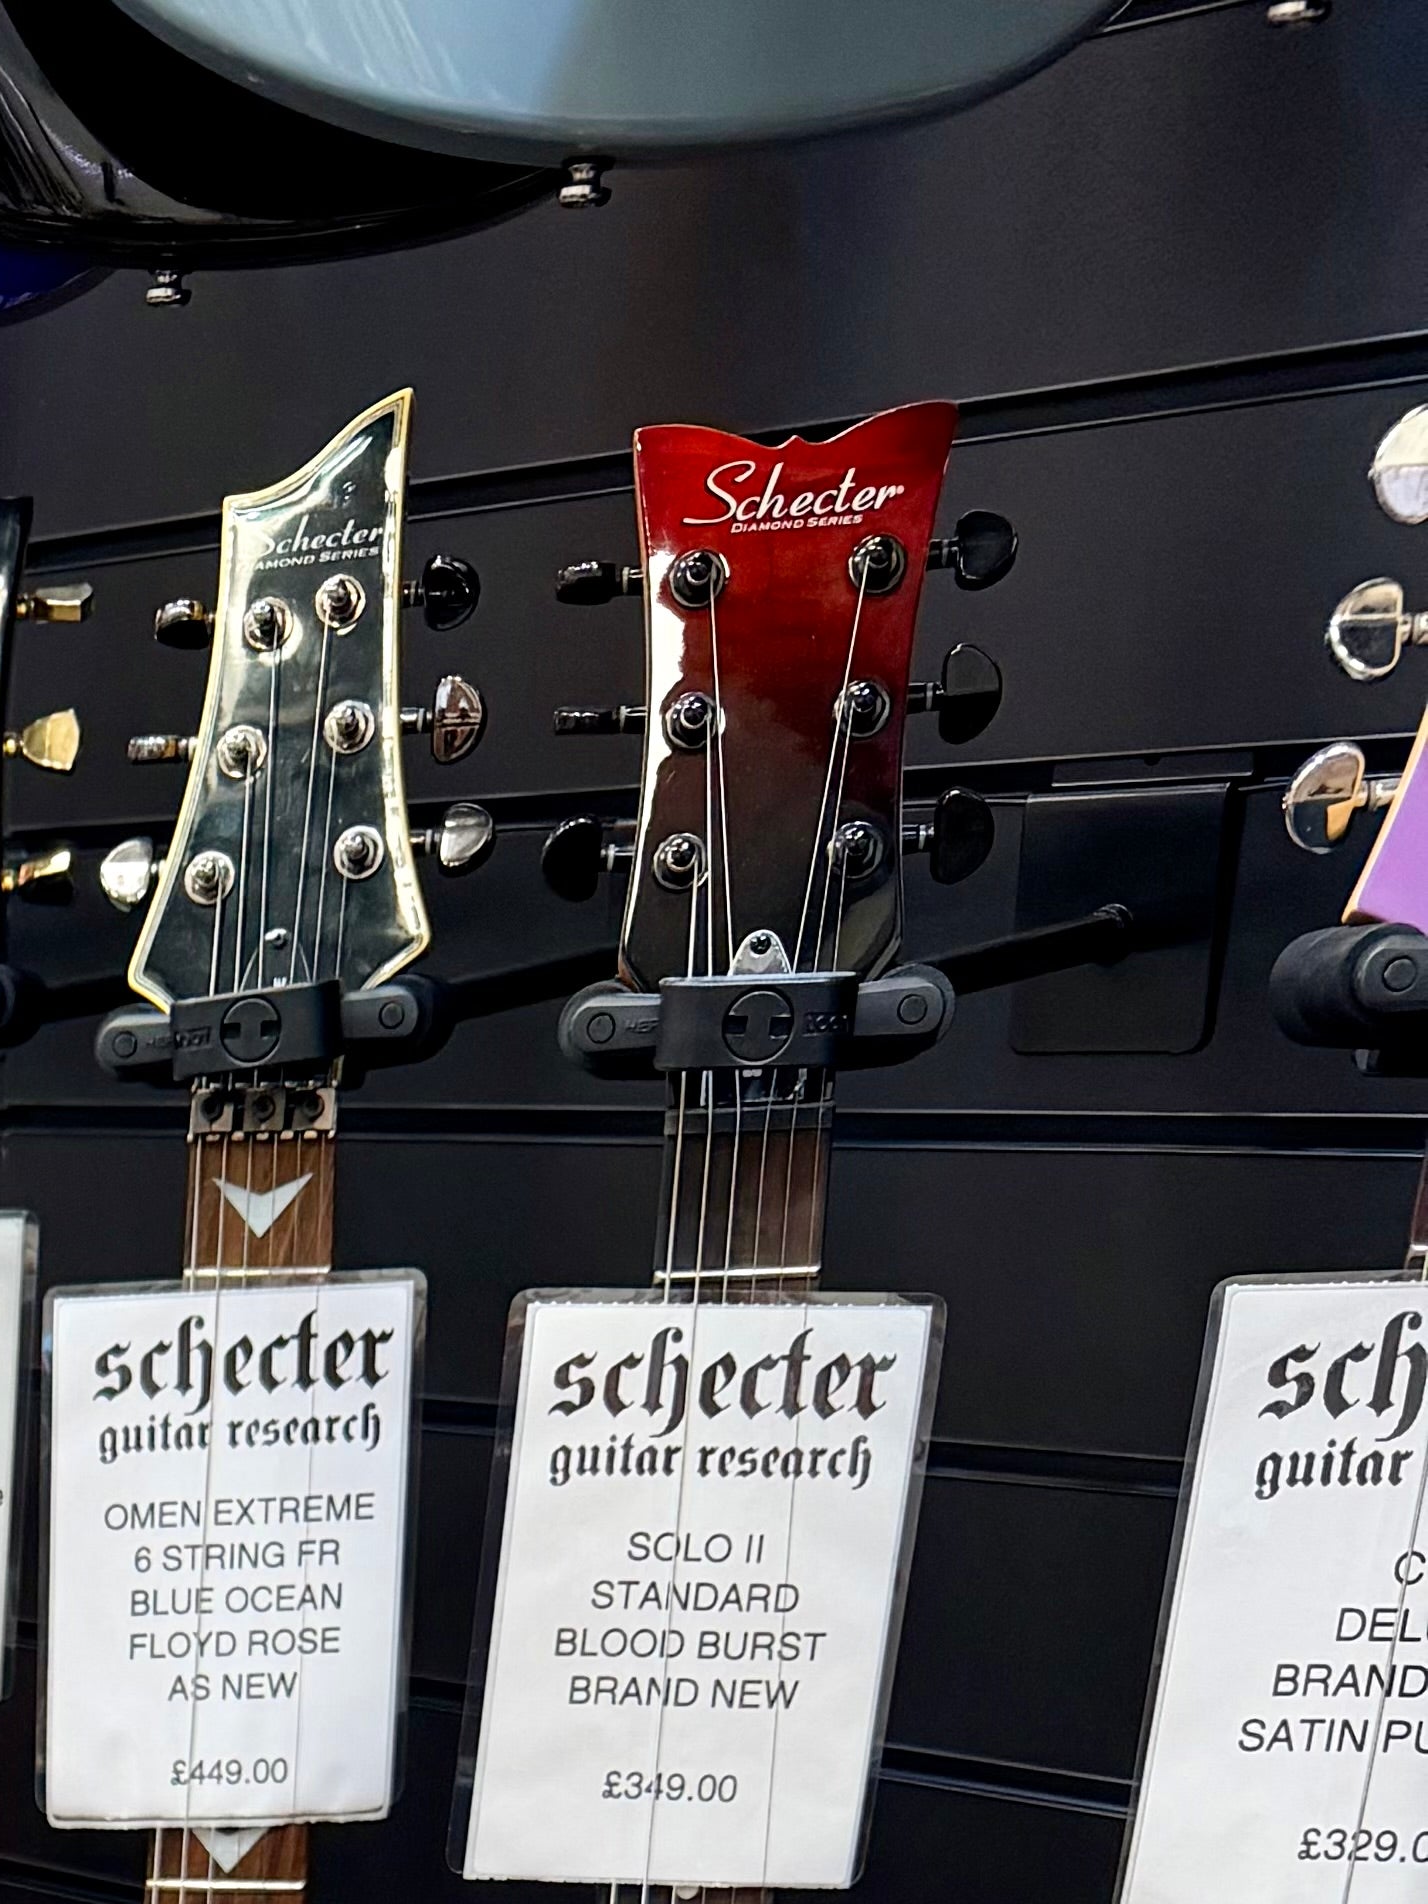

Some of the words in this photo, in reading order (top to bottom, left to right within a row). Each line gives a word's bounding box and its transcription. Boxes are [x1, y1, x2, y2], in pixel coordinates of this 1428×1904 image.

[683, 460, 900, 524] Schecter
[730, 518, 805, 534] DIAMOND
[807, 514, 864, 528] SERIES
[318, 546, 380, 563] SERIES
[93, 1309, 395, 1416] schecter
[548, 1326, 898, 1439] schecter
[98, 1411, 212, 1464] guitar
[228, 1402, 381, 1451] research
[549, 1433, 683, 1487] guitar
[696, 1434, 874, 1491] research
[1255, 1437, 1413, 1501] guitar
[104, 1501, 202, 1530] OMEN
[214, 1492, 376, 1526] EXTREME
[133, 1546, 153, 1573] 6
[162, 1541, 285, 1571] STRING
[297, 1538, 341, 1566] FR
[627, 1531, 733, 1564] SOLO
[745, 1533, 765, 1564] II
[130, 1587, 214, 1616] BLUE
[225, 1583, 343, 1613] OCEAN
[590, 1580, 801, 1614] STANDARD
[1335, 1607, 1428, 1643] DEL
[128, 1630, 237, 1660] FLOYD
[247, 1626, 341, 1656] ROSE
[554, 1628, 685, 1659] BLOOD
[697, 1631, 828, 1662] BURST
[168, 1674, 211, 1702] AS
[222, 1671, 298, 1700] NEW
[568, 1675, 700, 1708] BRAND
[711, 1679, 800, 1710] NEW
[1272, 1663, 1428, 1698] BRAND
[1239, 1718, 1369, 1753] SATIN
[171, 1757, 289, 1786] £449.00
[601, 1770, 739, 1803] £349.00
